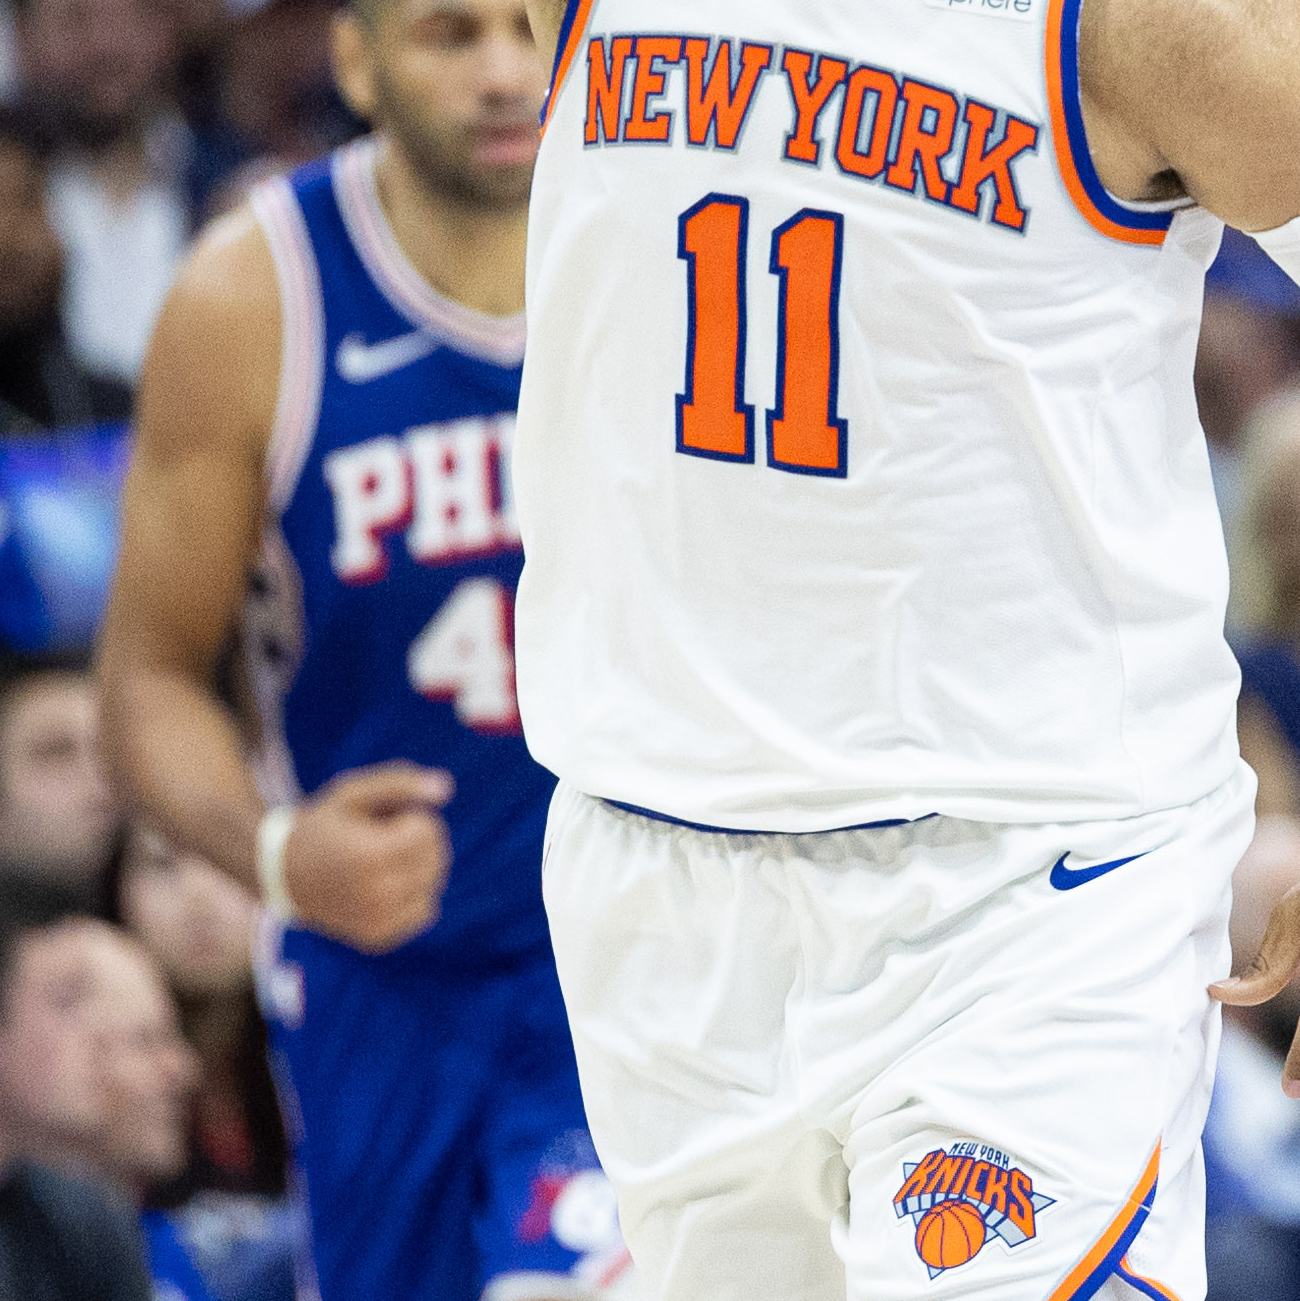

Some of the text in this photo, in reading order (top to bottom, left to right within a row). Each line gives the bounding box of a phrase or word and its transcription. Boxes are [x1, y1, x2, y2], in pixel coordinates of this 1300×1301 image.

[583, 33, 1041, 234] NEW YORK
[675, 192, 847, 478] 11
[892, 1148, 1036, 1239] KNICKS
[949, 1142, 1010, 1168] NEW YORK
